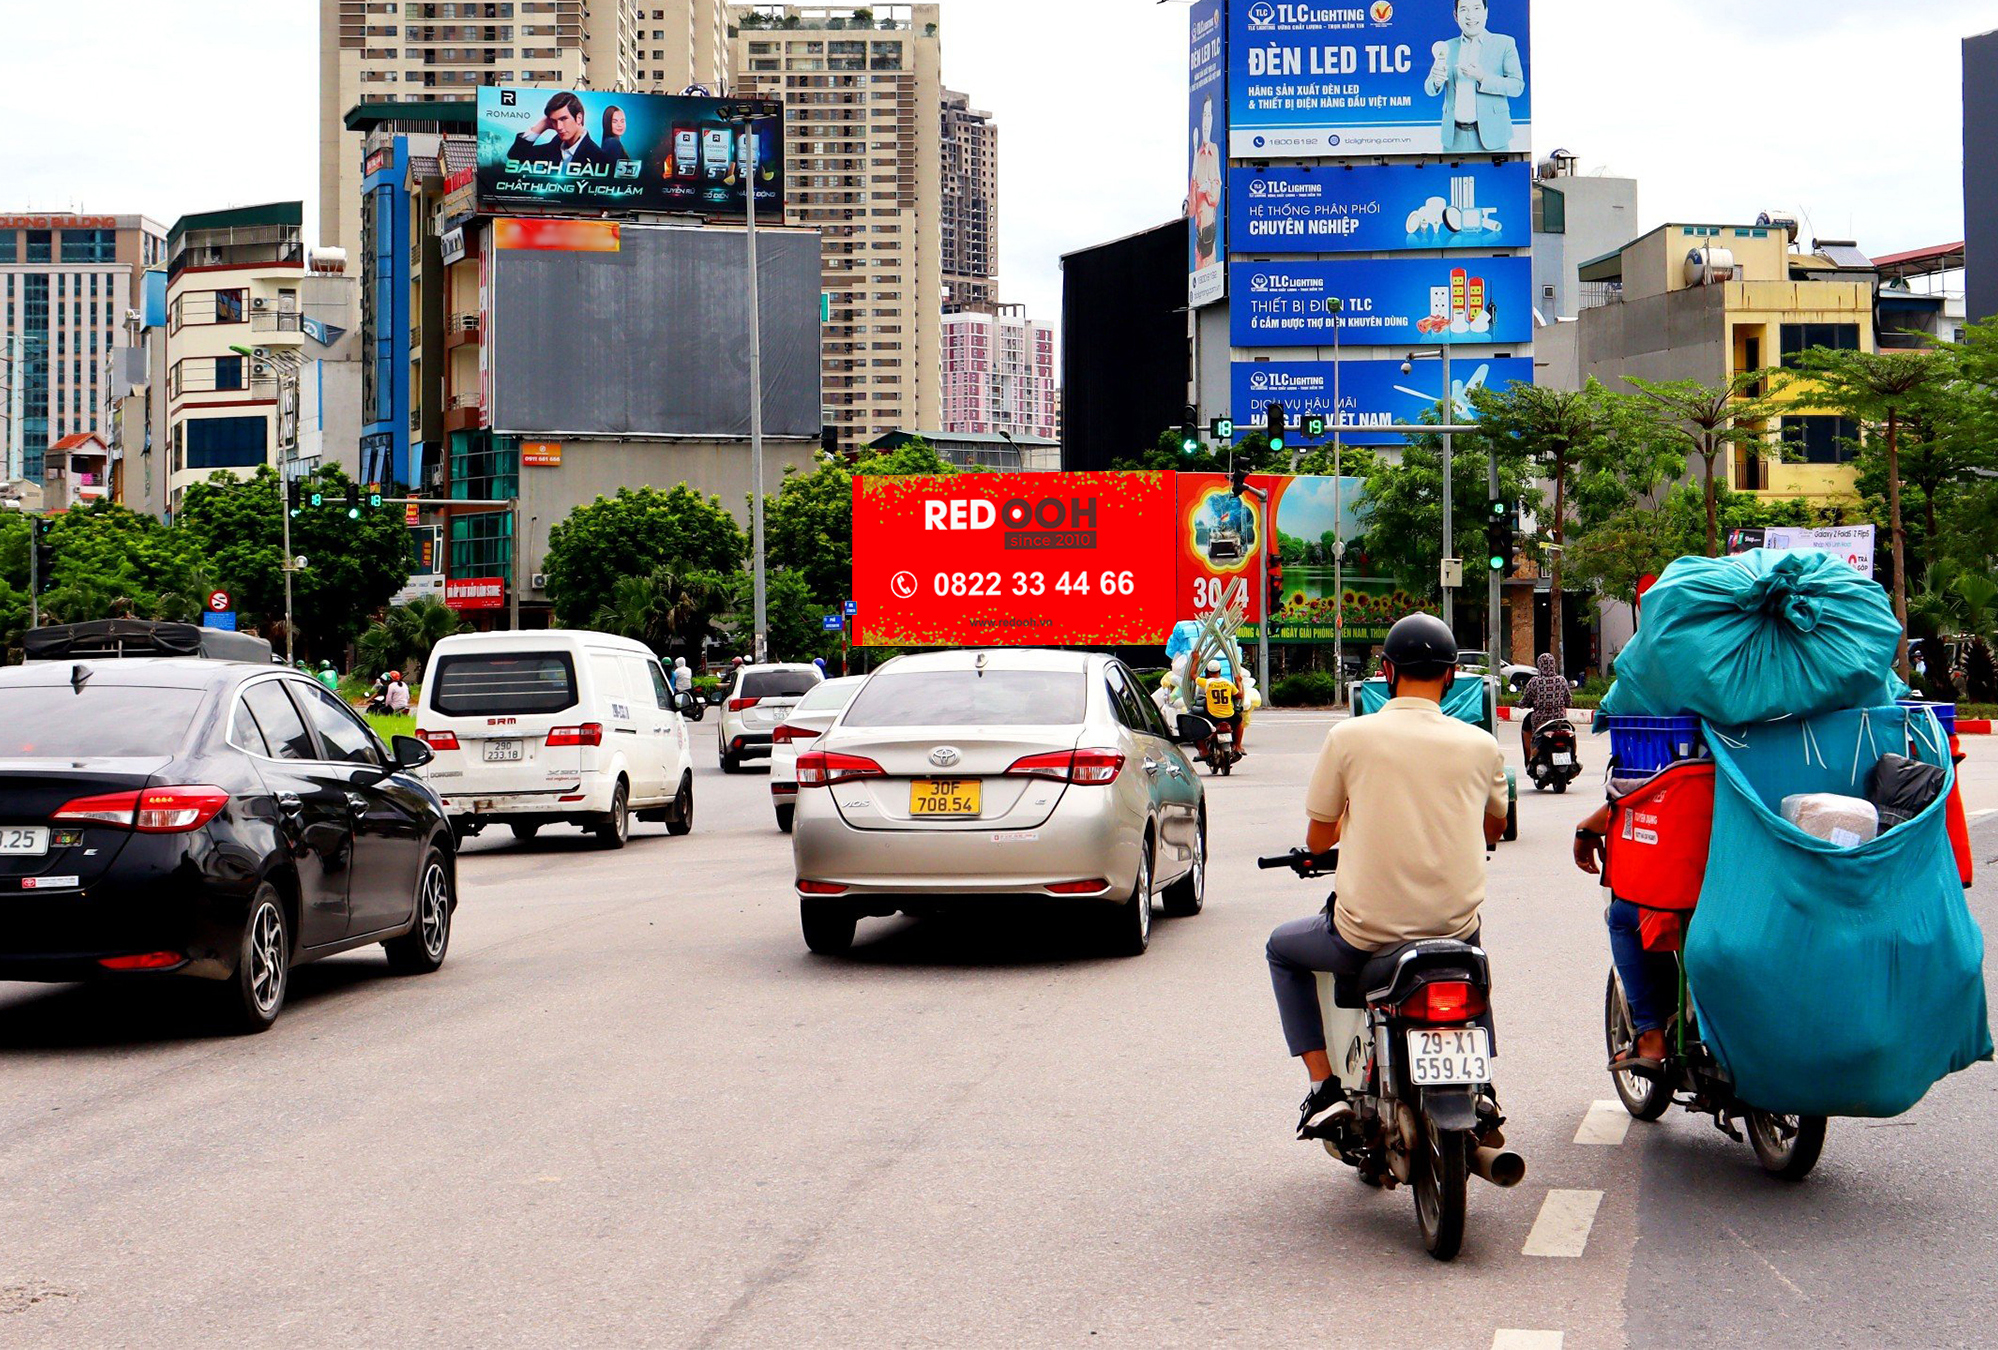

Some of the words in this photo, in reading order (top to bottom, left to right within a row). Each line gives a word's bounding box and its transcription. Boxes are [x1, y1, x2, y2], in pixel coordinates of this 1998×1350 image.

[1277, 4, 1308, 23] TLC
[1310, 8, 1364, 22] LIGHTING
[1248, 41, 1301, 76] ĐÈN
[1310, 46, 1357, 75] LED
[1365, 45, 1412, 73] TLC
[1275, 83, 1295, 96] SẢN
[1296, 82, 1320, 95] XUẤT
[1322, 83, 1341, 95] ĐÈN
[1343, 84, 1360, 95] LED
[1248, 100, 1256, 110] &
[1258, 96, 1283, 109] THIẾT
[1285, 98, 1295, 111] BỊ
[1297, 97, 1318, 110] ĐIỆN
[1320, 95, 1346, 108] HÀNG
[1368, 94, 1387, 109] VIỆT
[1389, 96, 1412, 107] NAM
[485, 109, 531, 119] ROMANO
[504, 159, 562, 179] SẠCH
[565, 158, 610, 177] GÀU
[496, 179, 530, 191] CHẤT
[576, 179, 589, 194] Ý
[588, 186, 616, 196] LỊCH
[616, 184, 644, 195] LÃM
[1267, 180, 1287, 193] TLC
[1288, 184, 1322, 193] LIGHTING
[1249, 204, 1264, 218] HỆ
[1268, 203, 1311, 216] THỐNG
[1314, 203, 1348, 215] PHÂN
[1351, 201, 1380, 214] PHỐI
[1249, 217, 1304, 236] CHUYÊN
[1308, 216, 1360, 237] NGHIỆP
[1269, 275, 1289, 287] TLC
[1289, 278, 1324, 287] LIGHTING
[1251, 296, 1287, 313] THIẾT
[1292, 299, 1305, 315] BỊ
[1349, 298, 1372, 311] TLC
[1281, 317, 1305, 330] ĐƯỢC
[1307, 317, 1324, 330] THỢ
[1348, 316, 1383, 328] KHUYÊN
[1384, 314, 1409, 327] DÙNG
[1269, 373, 1289, 386] TLC
[1289, 376, 1324, 386] LIGHTING
[1284, 399, 1300, 410] VỤ
[1304, 397, 1330, 411] HẬU
[1309, 419, 1322, 434] 19
[1358, 412, 1392, 427] NAM
[1217, 420, 1232, 437] 18
[925, 499, 996, 531] RED
[1001, 497, 1097, 529] OOH
[1010, 534, 1050, 547] since
[1055, 533, 1090, 547] 2010
[1814, 530, 1833, 540] Galaxy
[933, 571, 1001, 597] 0822
[1011, 571, 1046, 597] 33
[1055, 570, 1090, 596] 44
[1099, 570, 1135, 596] 66
[969, 617, 1053, 628] www.redooh.vn
[1280, 624, 1298, 638] NGÀY
[1313, 625, 1335, 638] PHÓNG
[1211, 688, 1229, 705] 96
[487, 718, 517, 726] SRM
[495, 742, 512, 750] 29D
[487, 751, 519, 760] 233.18
[930, 781, 960, 796] 30F
[840, 800, 870, 808] VIOS
[917, 798, 972, 812] 708.54
[1415, 938, 1461, 948] HONDA
[1420, 1031, 1477, 1055] 29-X1
[1416, 1056, 1486, 1081] 559.43
